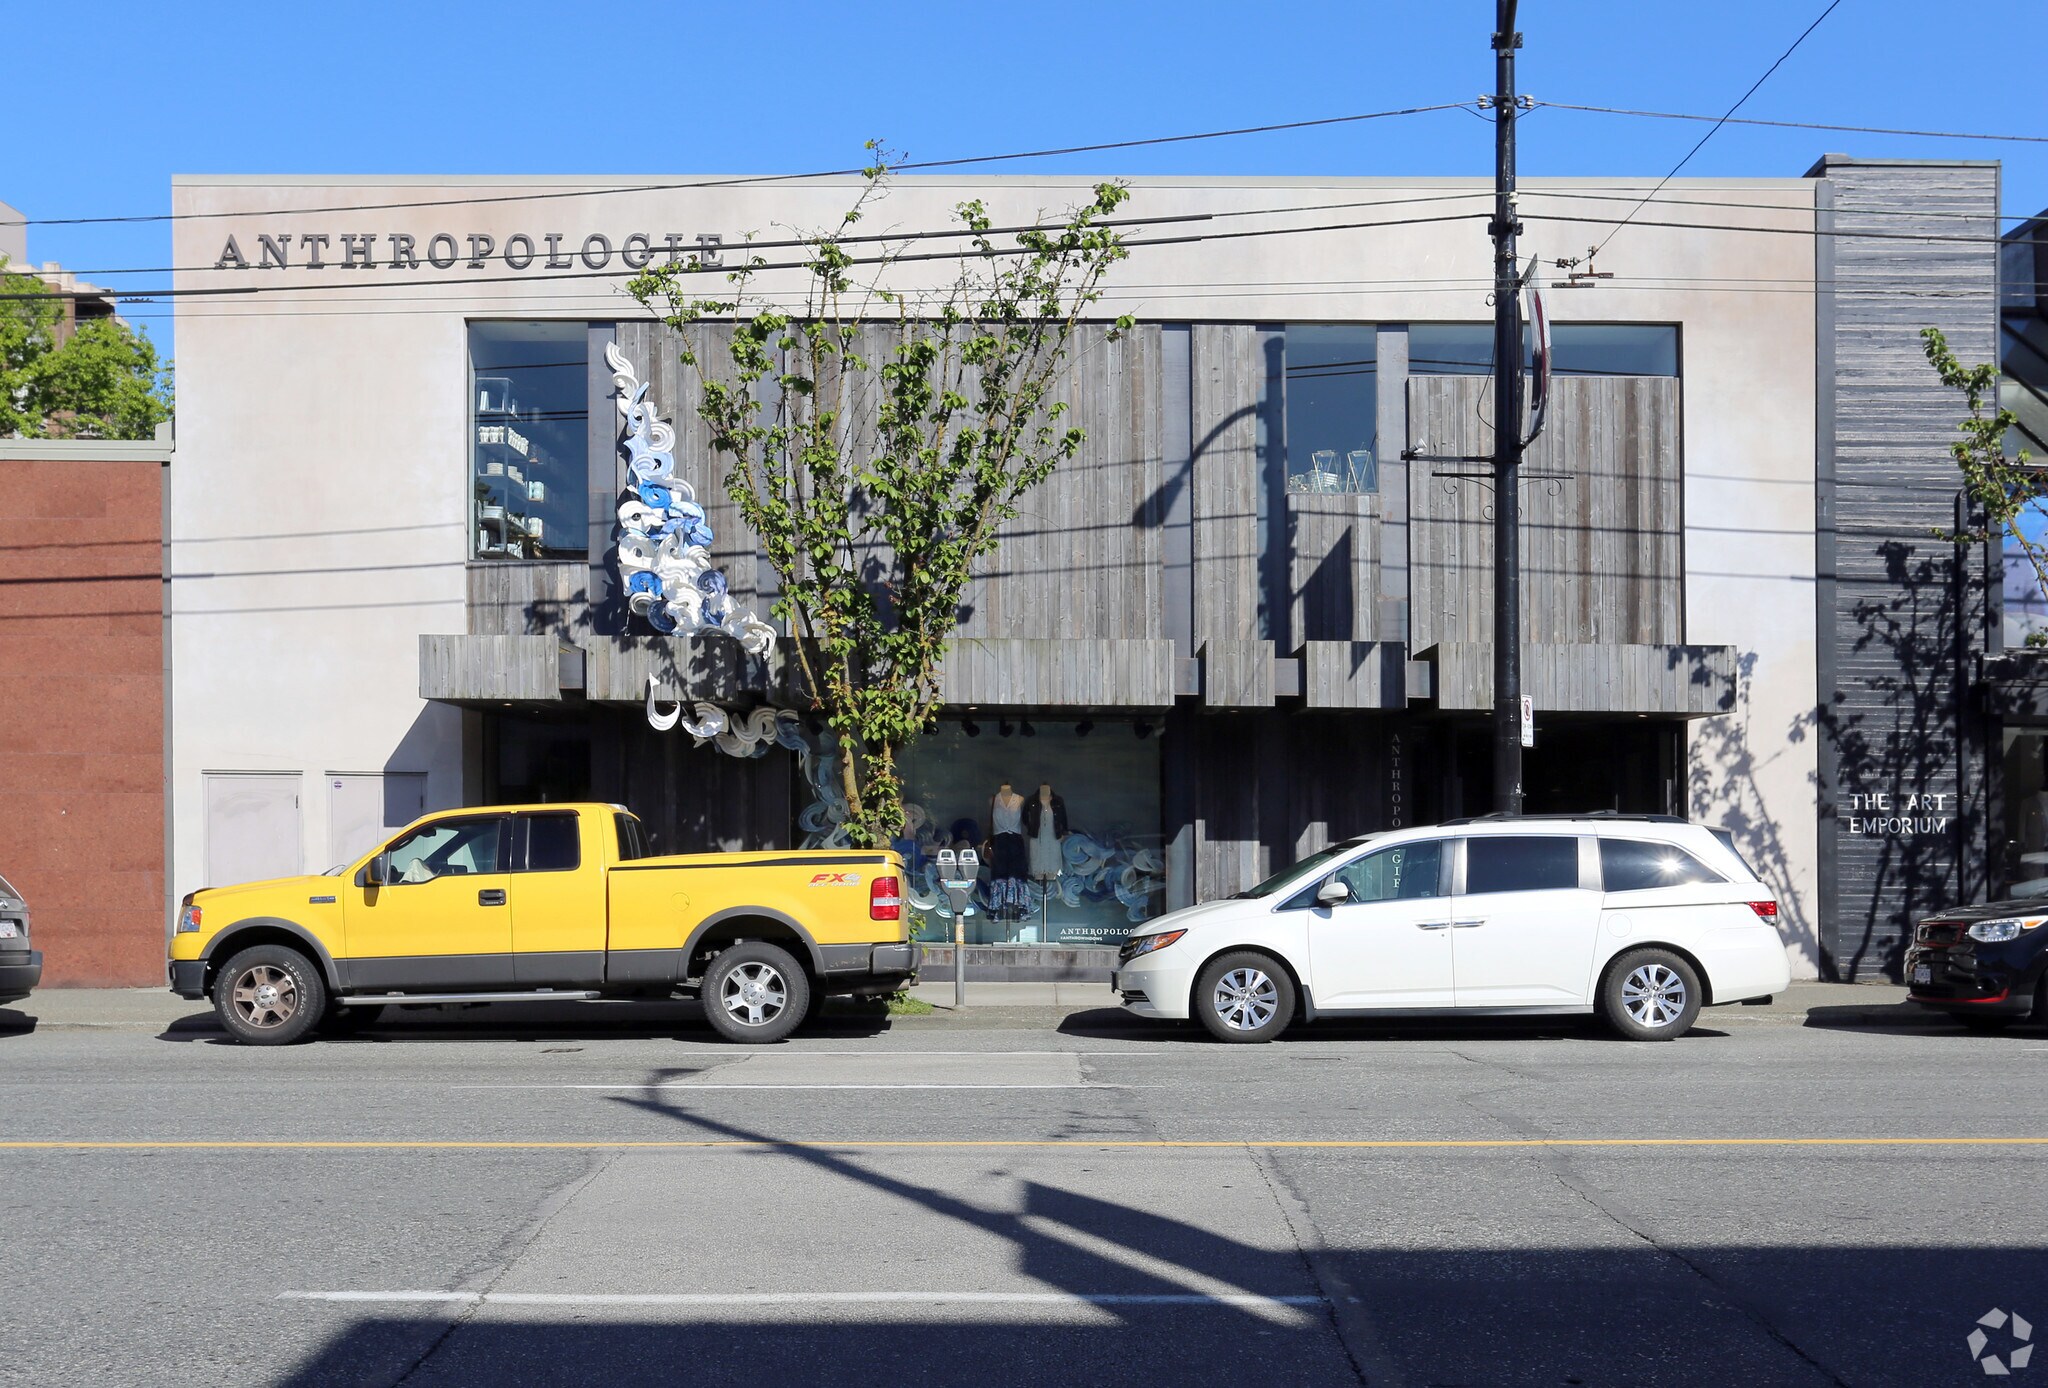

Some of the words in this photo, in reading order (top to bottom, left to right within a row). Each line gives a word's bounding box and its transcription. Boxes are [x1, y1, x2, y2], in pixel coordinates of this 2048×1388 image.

[214, 232, 723, 270] ANTHROPOLOGIE
[1849, 793, 1890, 811] THE
[1907, 794, 1947, 811] ART
[1849, 817, 1947, 834] EMPORIUM
[810, 873, 861, 883] FX4
